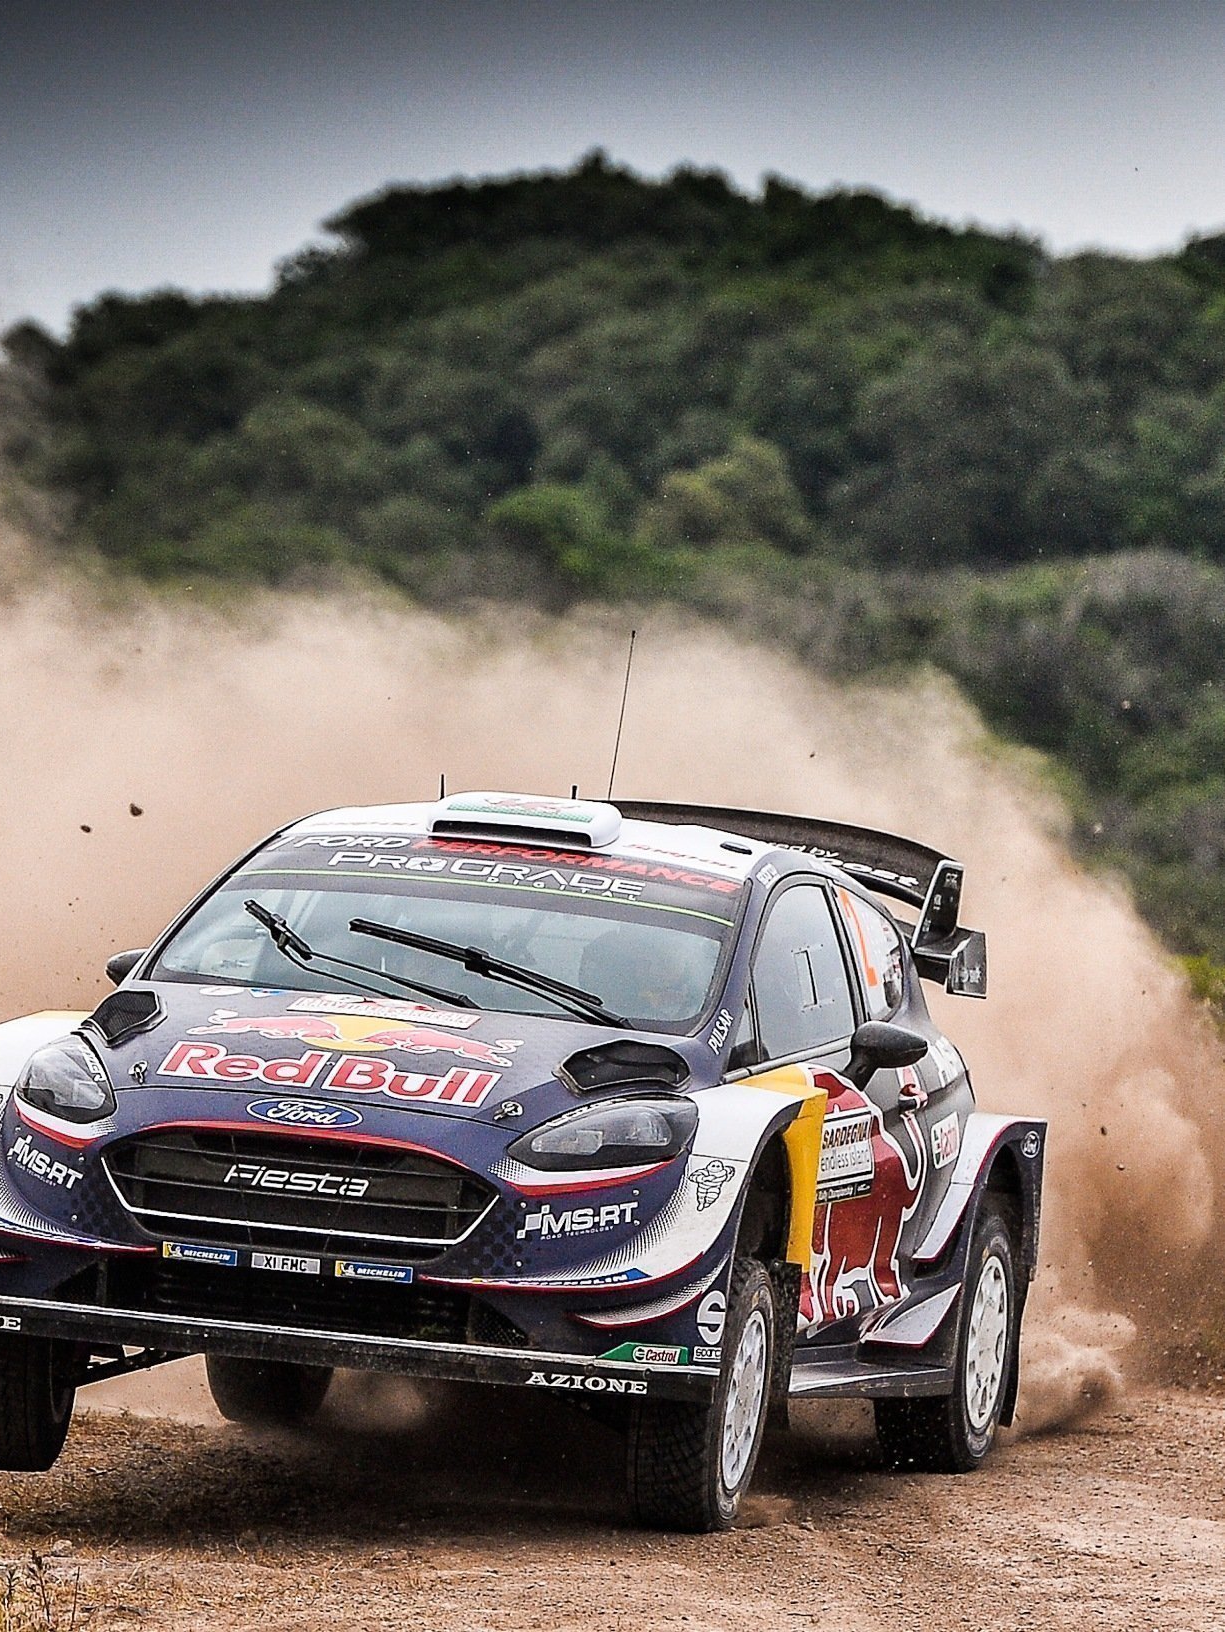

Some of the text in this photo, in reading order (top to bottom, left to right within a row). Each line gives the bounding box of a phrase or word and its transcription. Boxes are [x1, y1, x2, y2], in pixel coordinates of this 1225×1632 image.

[293, 835, 411, 849] FORD
[411, 838, 742, 893] PERFORMANCE
[486, 875, 637, 901] DIGITAL
[708, 1008, 734, 1055] PULSAR
[160, 1043, 320, 1086] Red
[327, 1057, 497, 1105] Bull
[266, 1100, 340, 1125] Ford
[822, 1120, 869, 1150] SARDEGNA
[183, 1249, 231, 1262] MICHELIN
[356, 1266, 406, 1279] MICHELIN
[645, 1348, 678, 1363] Castrol
[526, 1371, 648, 1395] AZIONE
